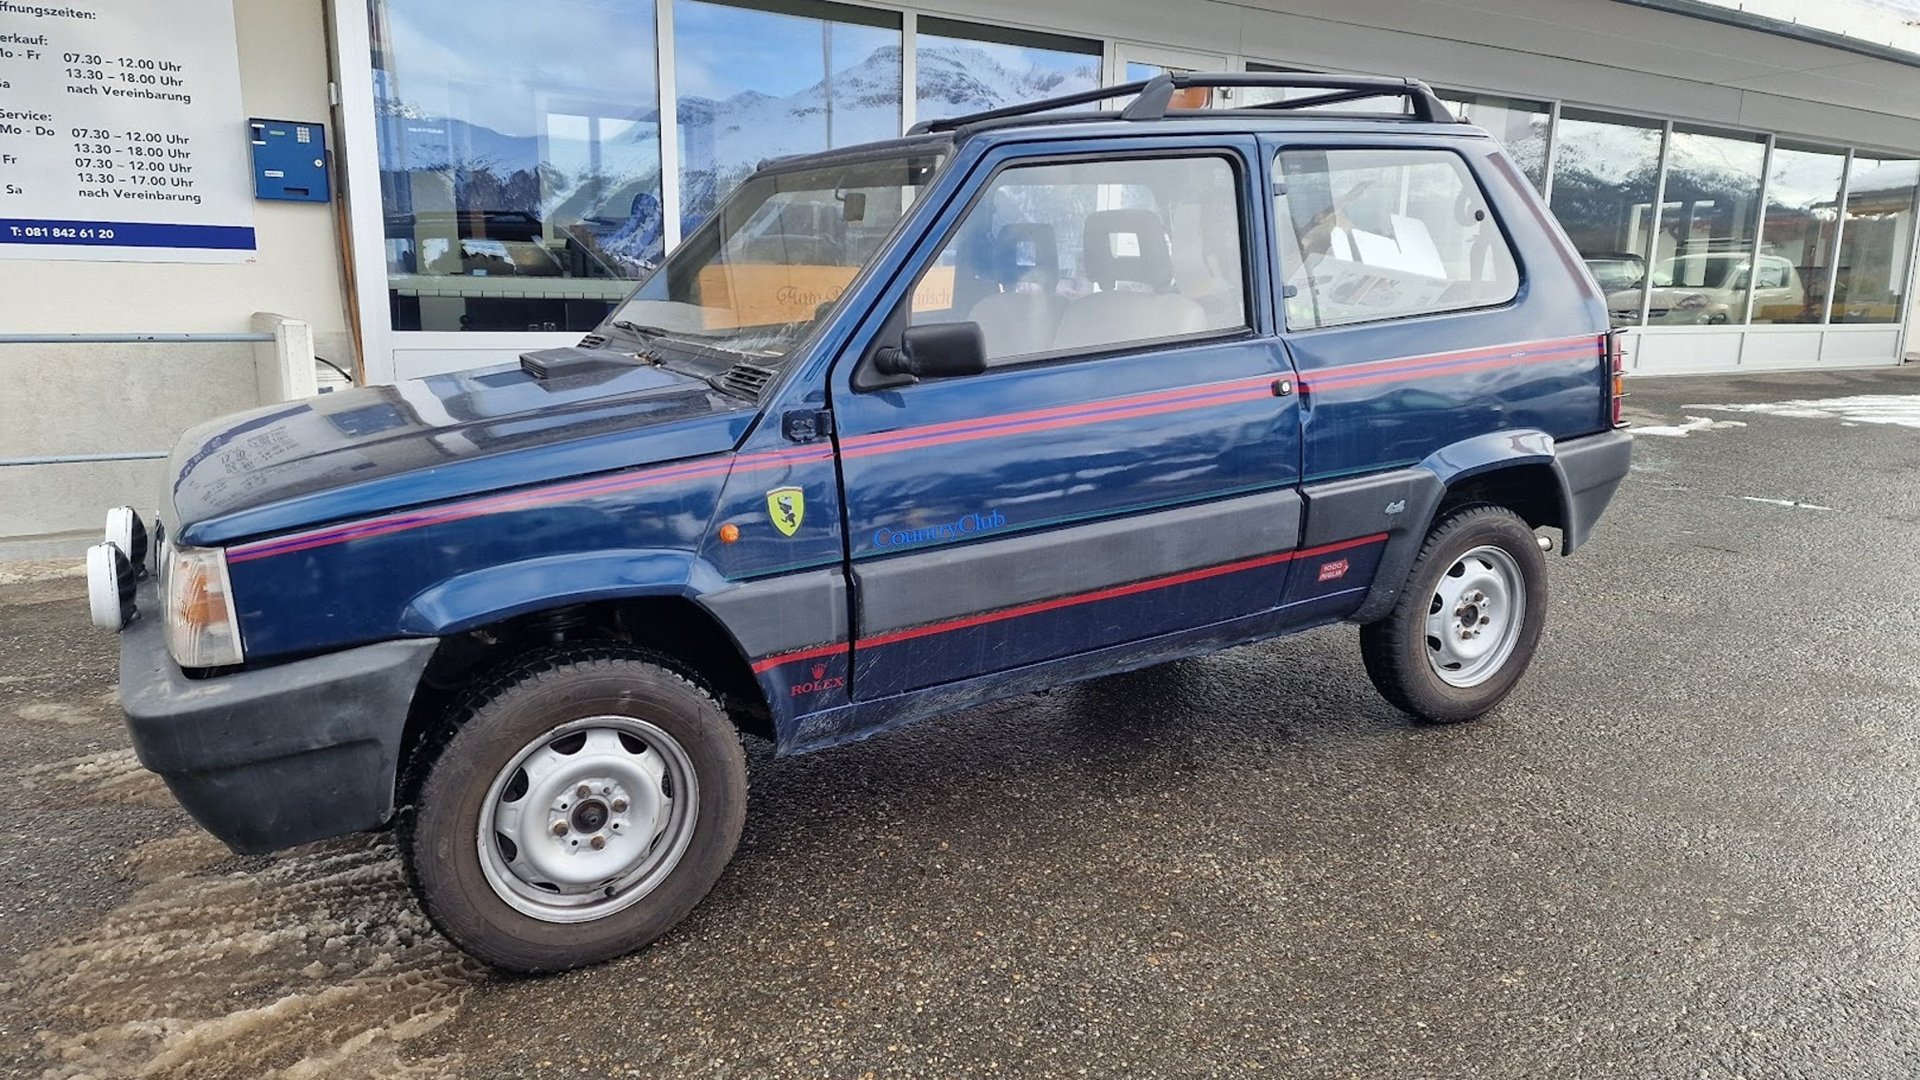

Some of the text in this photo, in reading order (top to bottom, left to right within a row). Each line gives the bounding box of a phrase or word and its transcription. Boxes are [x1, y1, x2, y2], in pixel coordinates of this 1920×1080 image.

[27, 49, 41, 60] Fr
[63, 53, 102, 65] 07.30
[118, 57, 154, 70] 12.00
[159, 61, 182, 72] Uhr
[65, 68, 103, 81] 13.30
[120, 73, 156, 85] 18.00
[160, 76, 184, 87] Uhr
[67, 84, 98, 95] nach
[102, 86, 191, 105] Vereinbarung
[0, 108, 52, 121] Service:
[0, 123, 22, 135] Mo
[35, 126, 55, 136] Do
[71, 128, 110, 140] 07.30
[126, 132, 162, 143] 12.00
[166, 134, 190, 144] Uhr
[74, 143, 112, 155] 13.30
[127, 146, 164, 158] 18.00
[168, 148, 191, 159] Uhr
[3, 154, 17, 164] Fr
[75, 158, 113, 169] 07.30
[129, 161, 165, 172] 12.00
[169, 163, 193, 173] Uhr
[77, 173, 115, 184] 13.30
[131, 175, 167, 187] 17.00
[171, 177, 195, 188] Uhr
[6, 184, 201, 204] Sa nach Vereinbarung
[10, 226, 114, 239] T: 081 842 61 20
[790, 676, 845, 697] ROLEX
